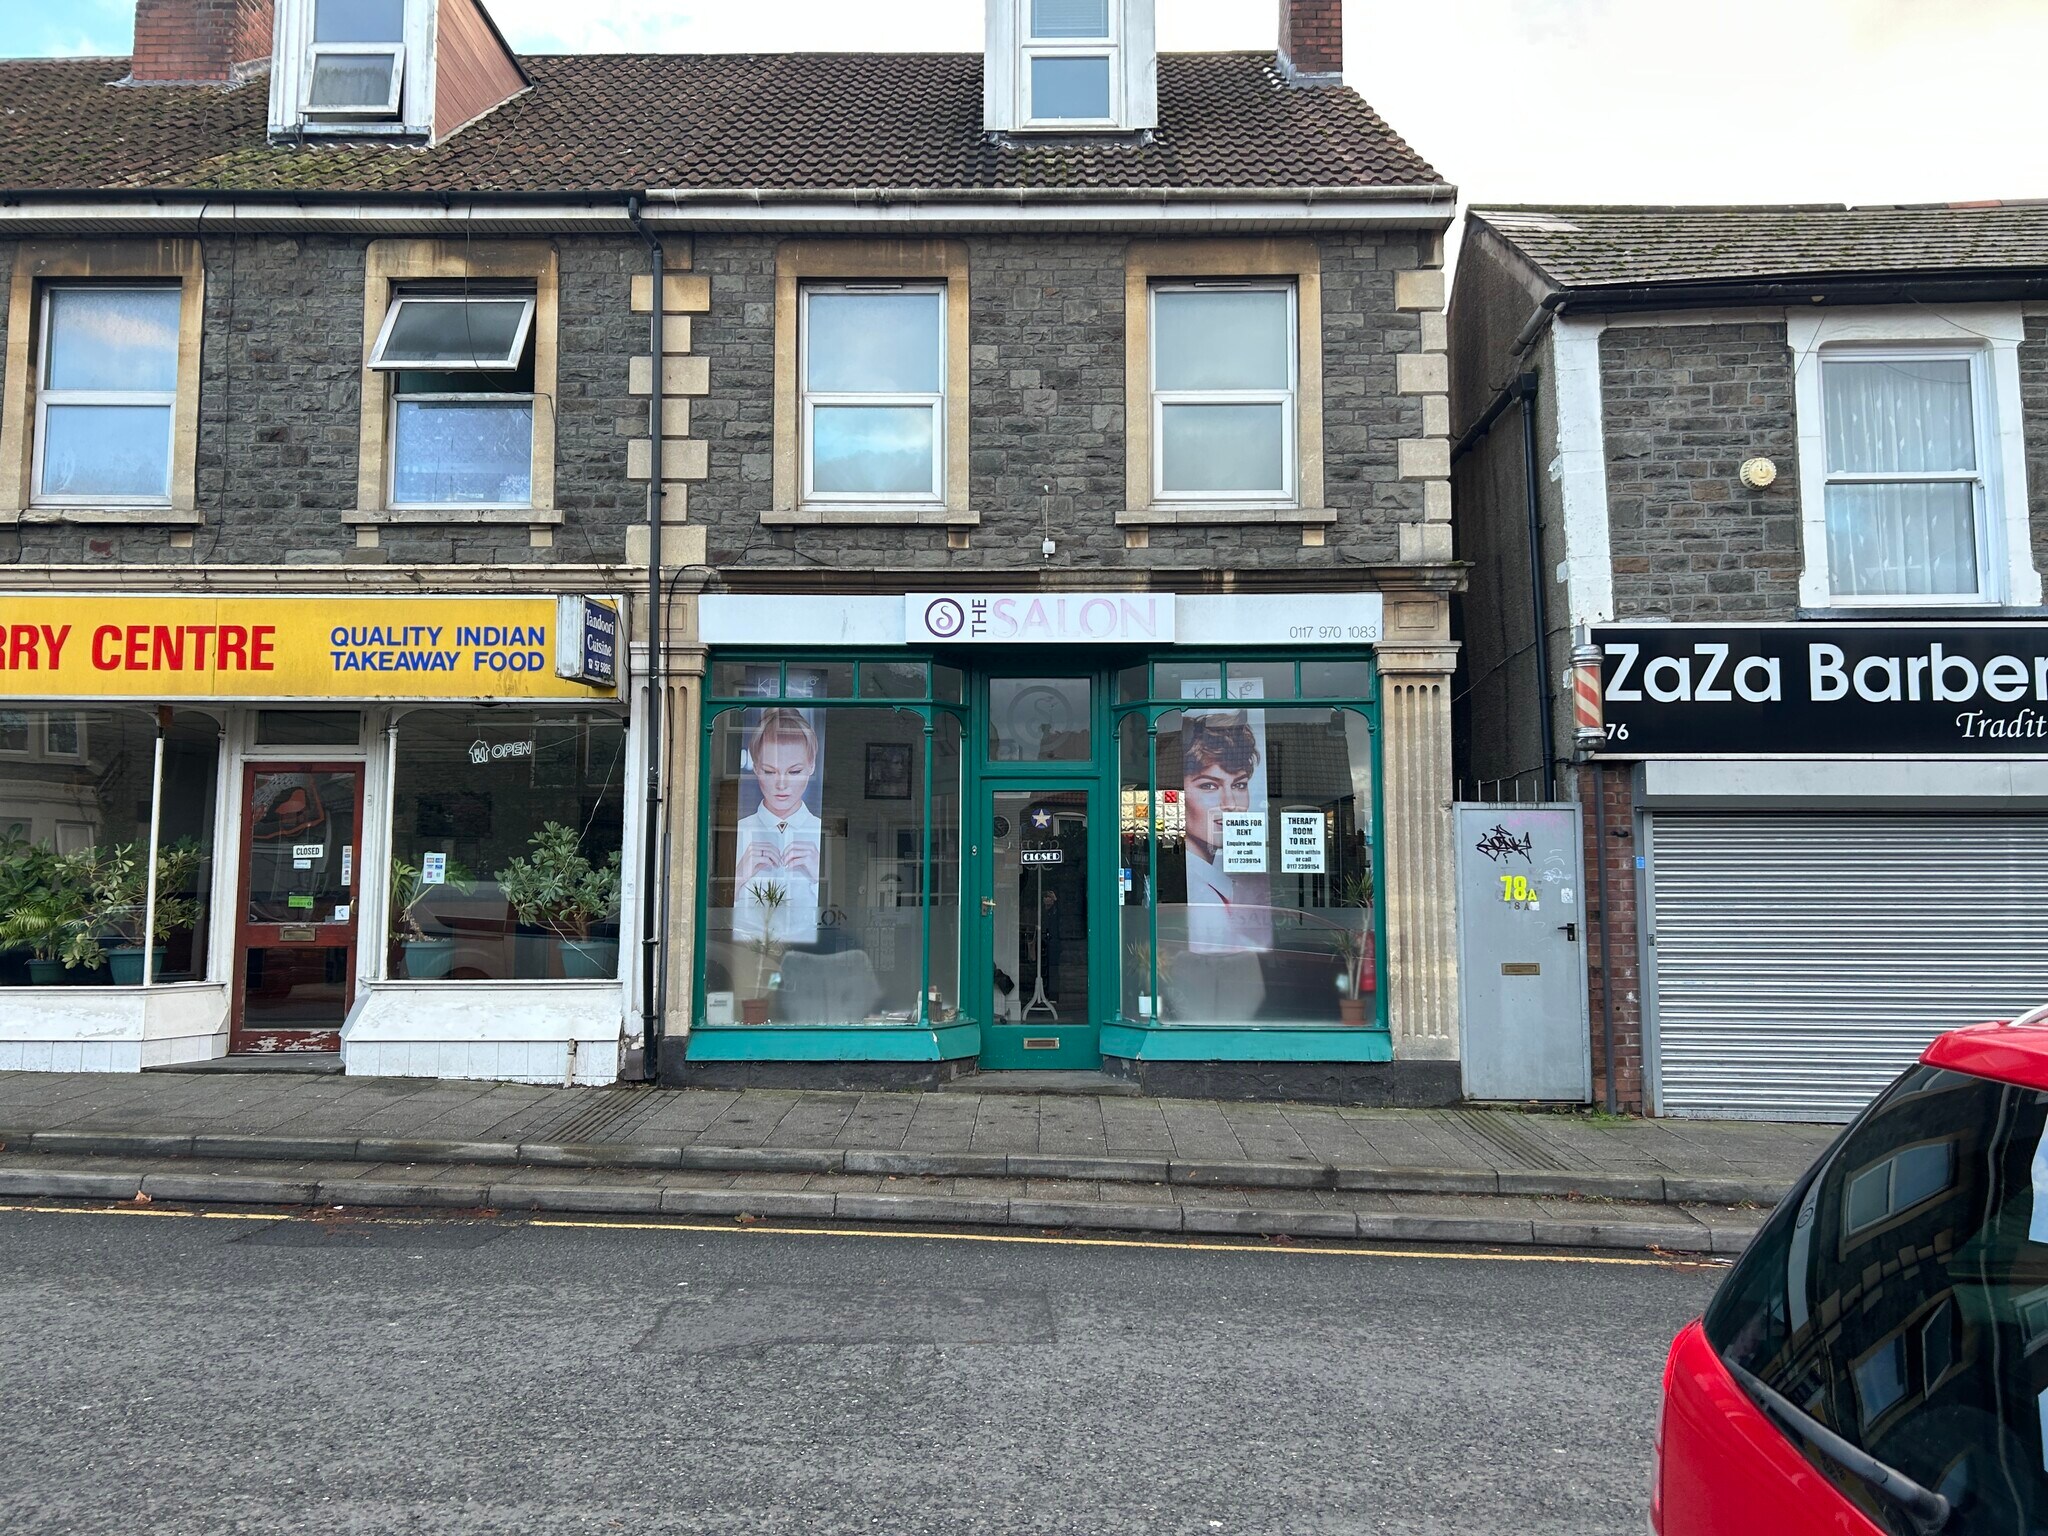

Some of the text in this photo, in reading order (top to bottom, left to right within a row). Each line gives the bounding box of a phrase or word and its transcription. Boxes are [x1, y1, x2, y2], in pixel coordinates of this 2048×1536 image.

[585, 608, 615, 635] Tandoori
[971, 598, 1156, 639] THE SALON
[330, 626, 545, 647] QUALITY INDIAN
[1289, 626, 1377, 639] 0117 970 1083
[0, 624, 275, 670] RY CENTRE
[587, 634, 613, 657] Cuisine
[330, 651, 545, 671] TAKEAWAY FOOD
[1604, 643, 1782, 702] ZaZa
[1605, 723, 1629, 740] 76
[1955, 708, 2048, 738] Tradit
[491, 740, 532, 759] OPEN
[1225, 819, 1263, 827] CHAIRS FOR
[1288, 817, 1318, 825] THERAPY
[1236, 828, 1252, 836] RENT
[1292, 827, 1313, 835] ROOM
[1289, 837, 1317, 845] TO RENT
[296, 847, 320, 855] CLOSED
[1023, 852, 1060, 861] CLOSED
[1500, 875, 1538, 901] 78A
